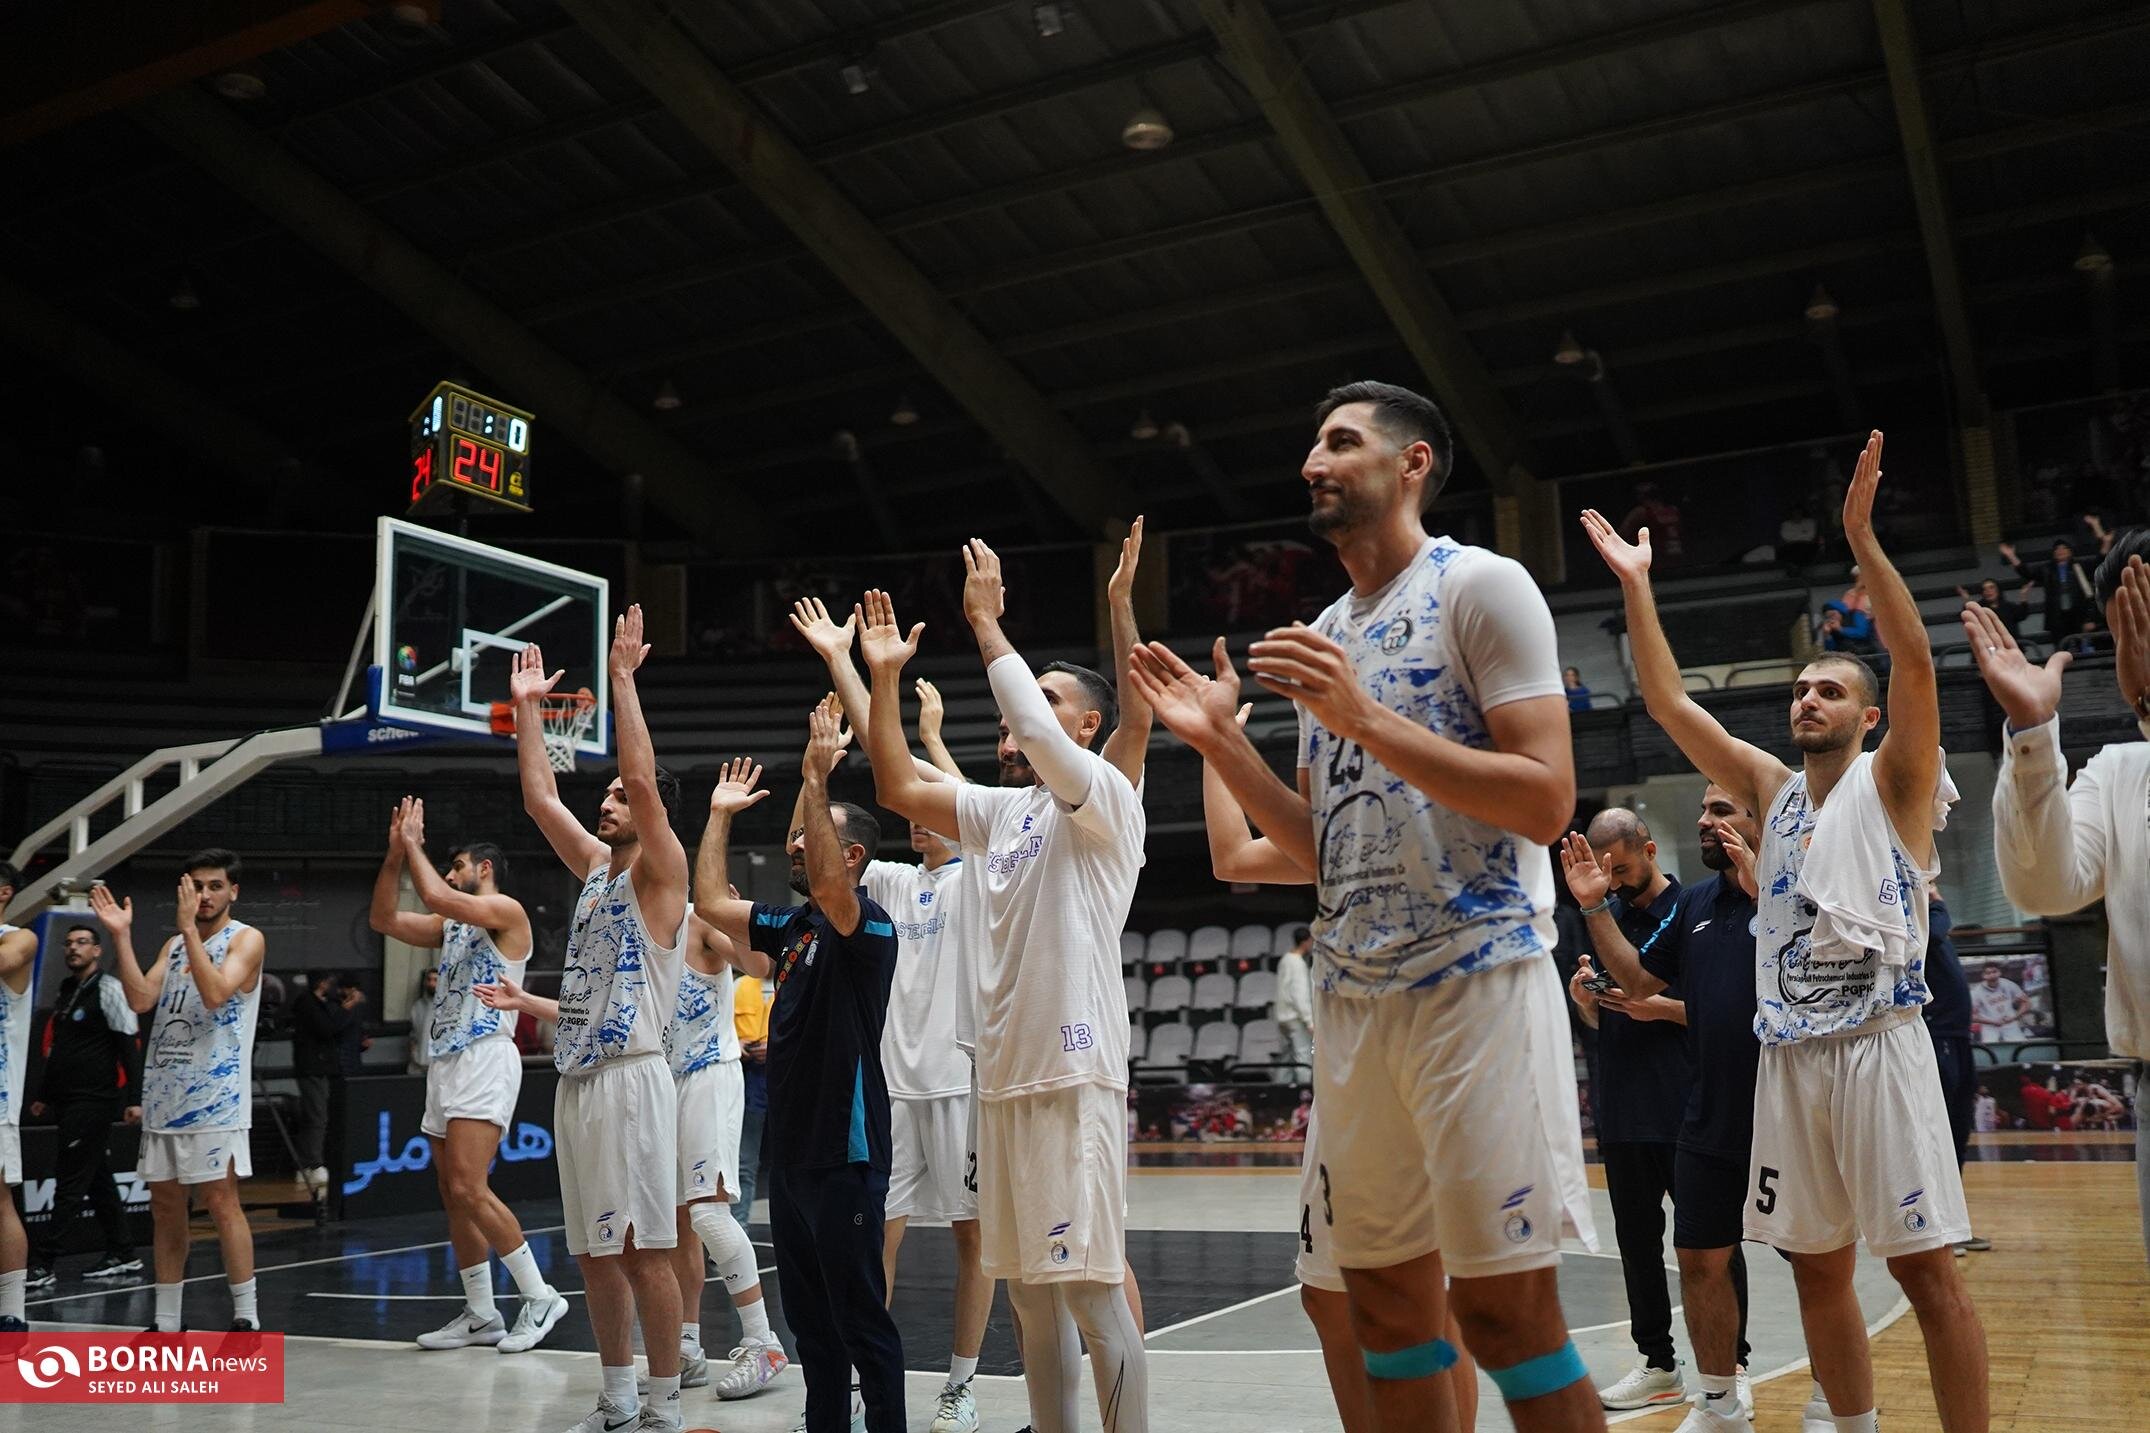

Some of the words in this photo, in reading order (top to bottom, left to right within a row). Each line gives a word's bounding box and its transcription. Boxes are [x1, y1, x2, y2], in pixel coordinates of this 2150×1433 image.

[453, 439, 500, 489] 24
[1878, 878, 1898, 906] 5
[1841, 982, 1875, 996] PGPIC
[1060, 1023, 1094, 1052] 13
[1755, 1165, 1779, 1216] 5
